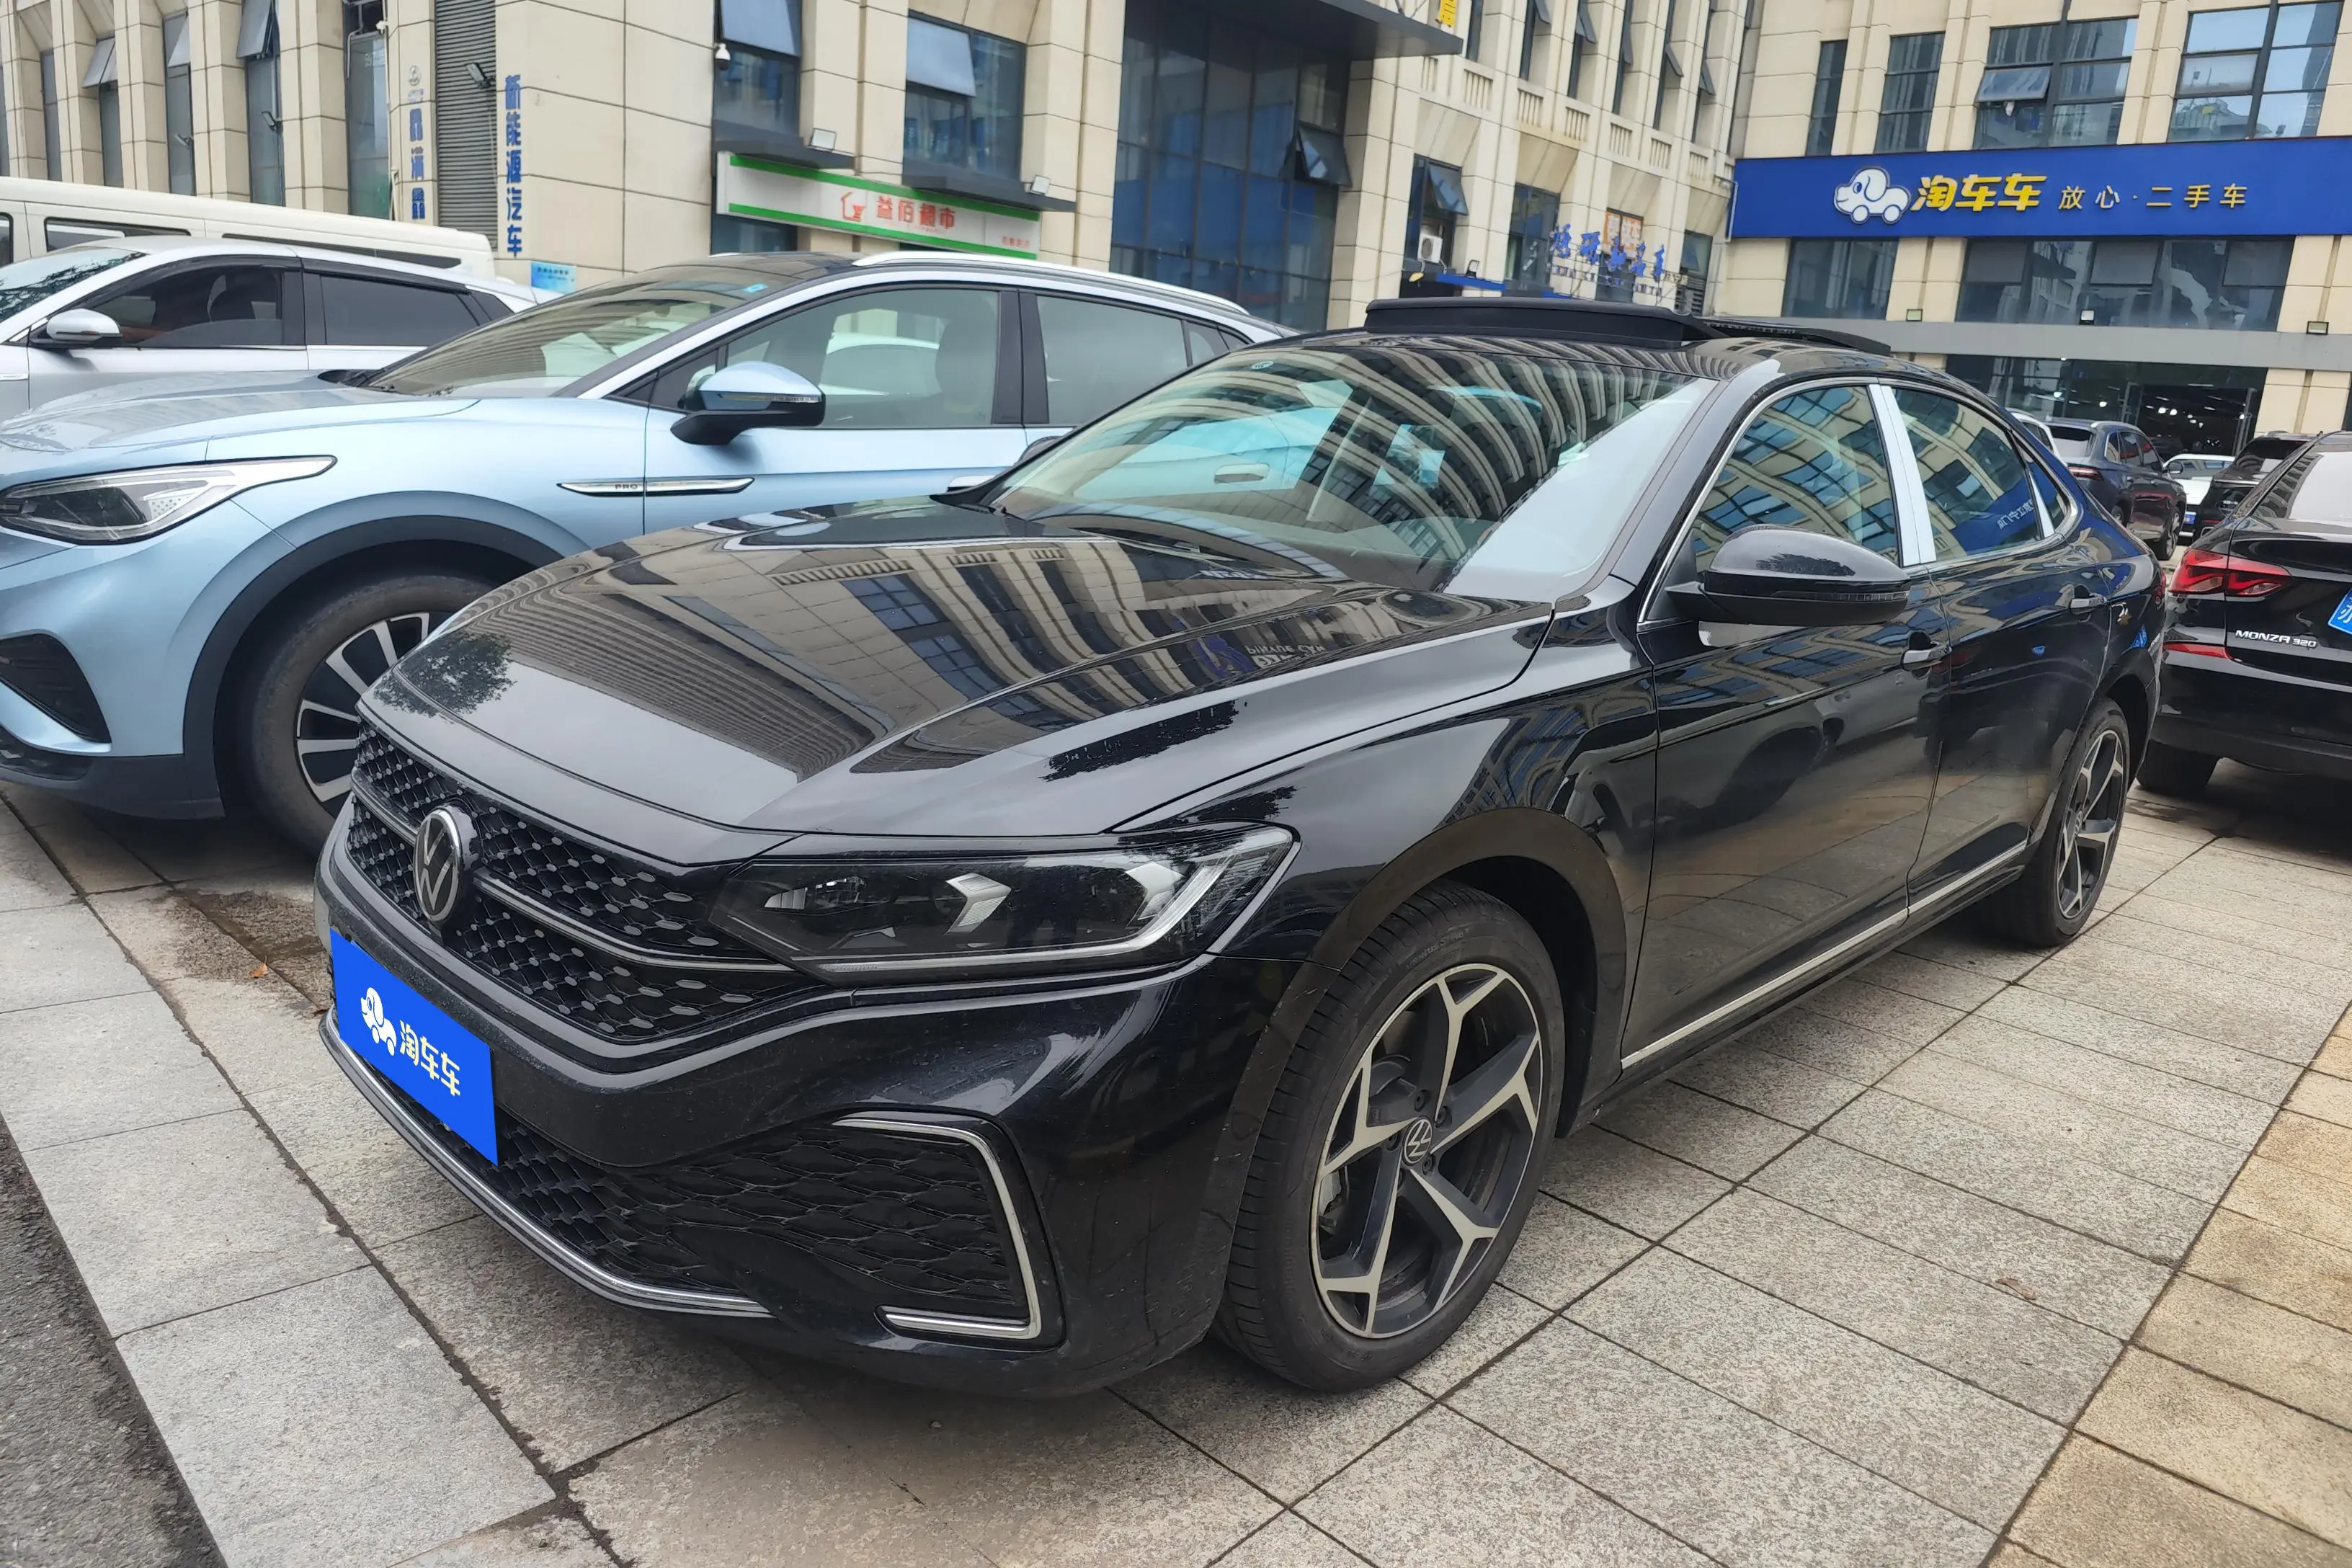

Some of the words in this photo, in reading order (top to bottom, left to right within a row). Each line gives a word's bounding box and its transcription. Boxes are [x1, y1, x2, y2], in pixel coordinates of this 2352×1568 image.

[505, 74, 522, 258] 新能源汽车
[1910, 172, 2047, 212] 淘车车
[2235, 629, 2291, 644] MONZA
[2291, 638, 2317, 648] 320
